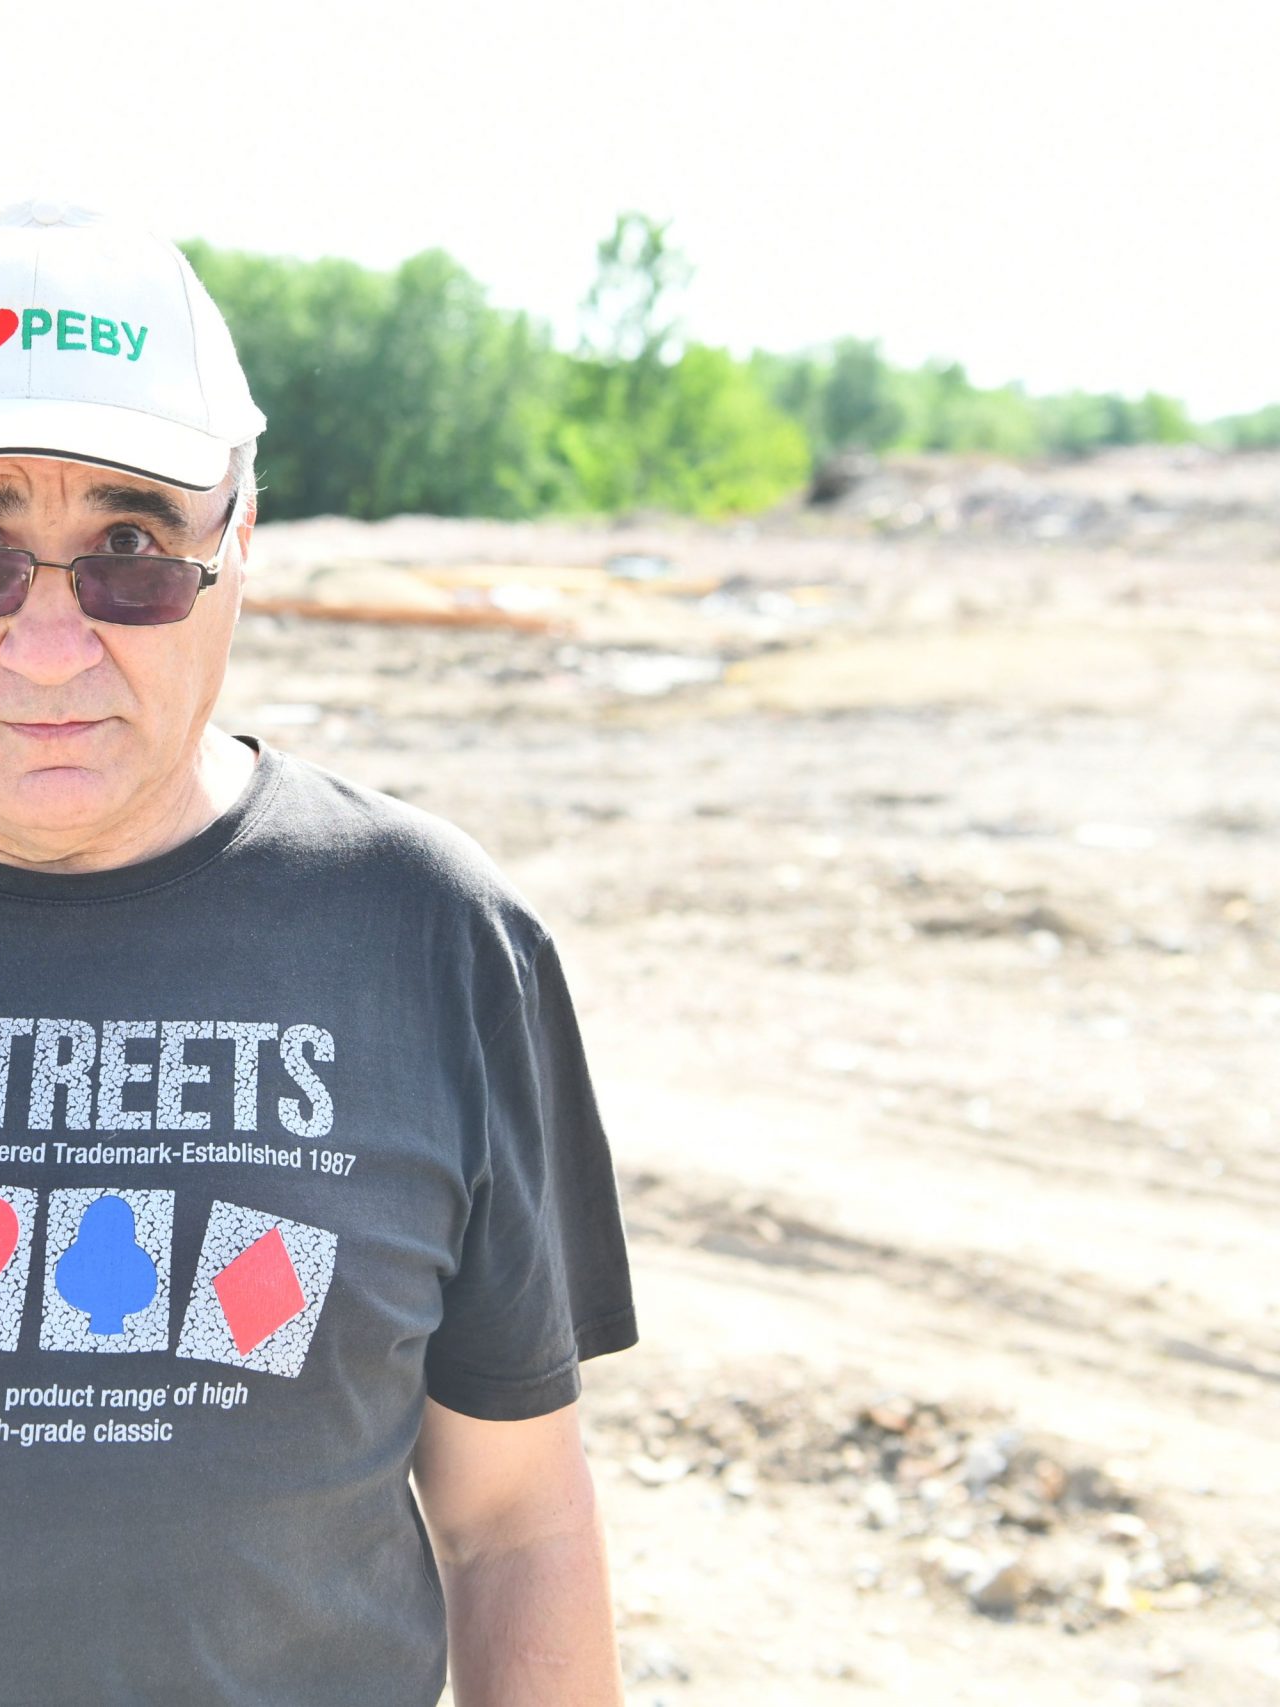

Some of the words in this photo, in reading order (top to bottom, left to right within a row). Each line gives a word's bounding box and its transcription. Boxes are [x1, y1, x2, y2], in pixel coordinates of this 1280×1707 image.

[52, 1141, 302, 1170] Trademark-Established
[308, 1148, 357, 1178] 1987
[4, 1383, 95, 1412] product
[173, 1381, 198, 1406] of
[201, 1381, 249, 1410] high
[93, 1418, 173, 1443] classic
